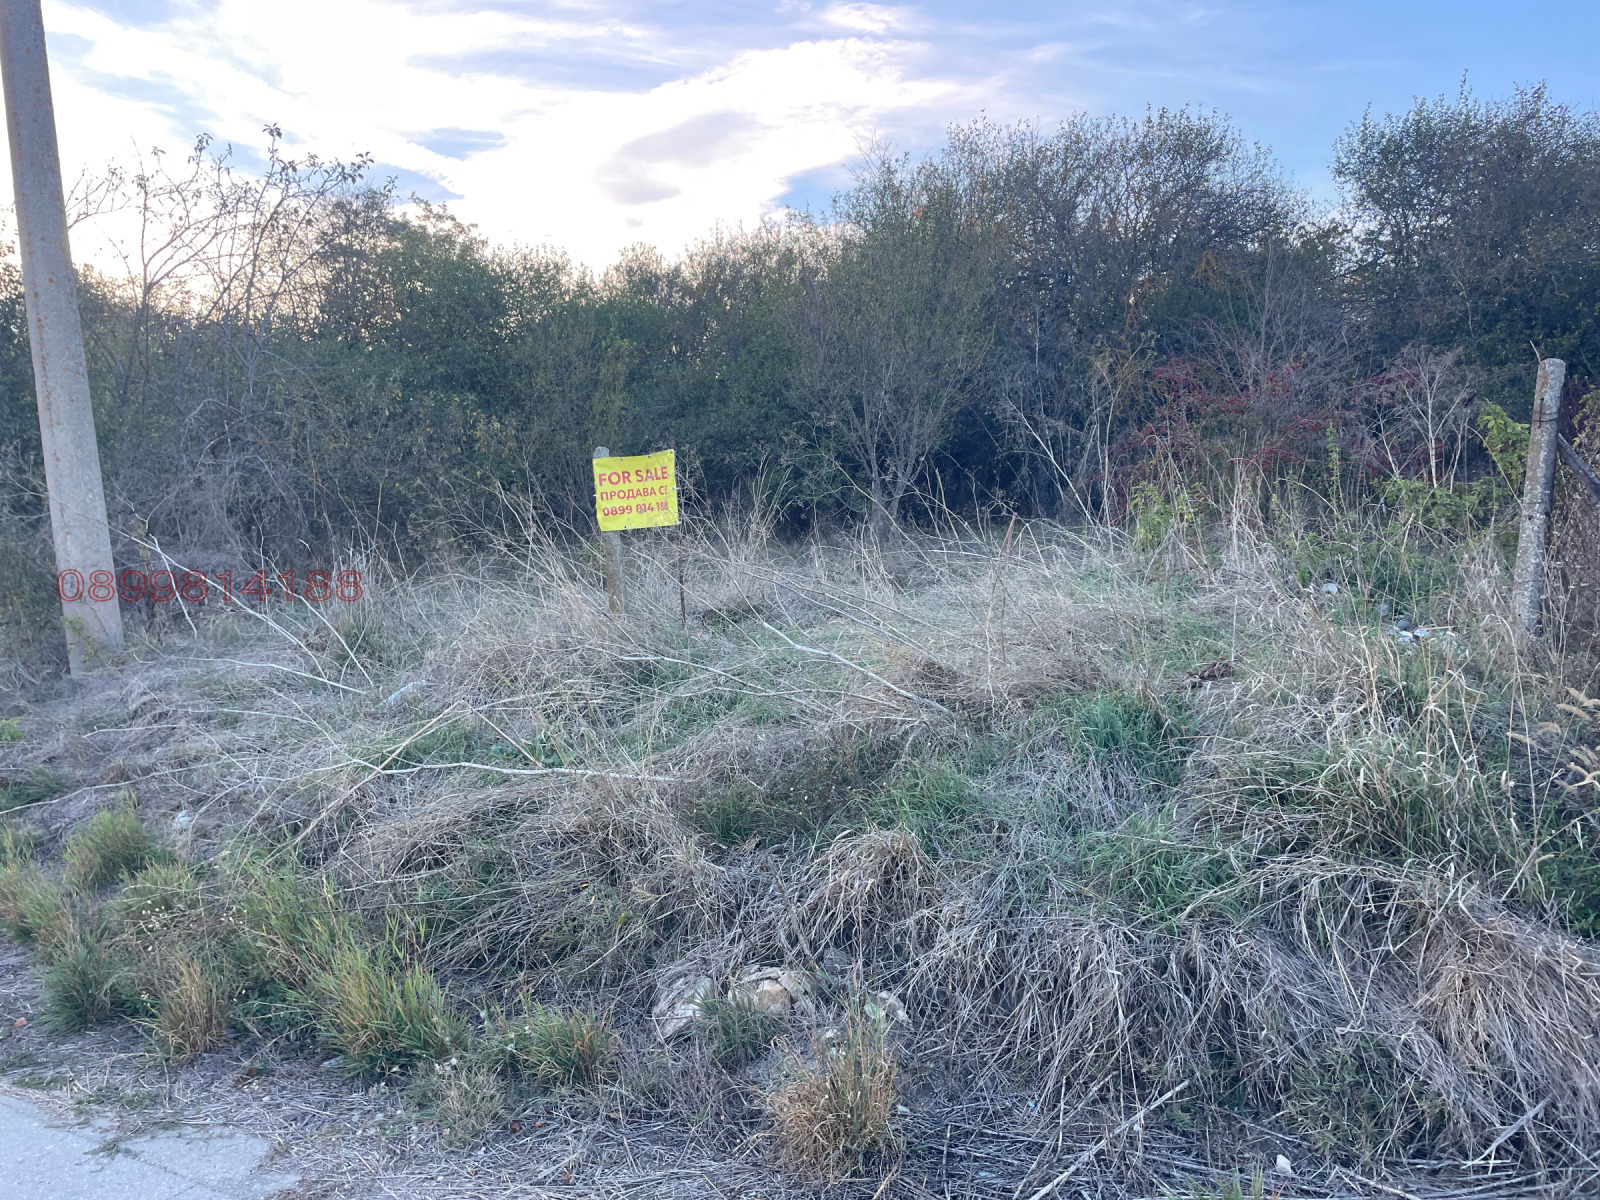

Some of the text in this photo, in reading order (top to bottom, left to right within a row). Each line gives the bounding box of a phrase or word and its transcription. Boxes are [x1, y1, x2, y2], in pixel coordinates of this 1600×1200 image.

[598, 466, 668, 486] FOR SALE
[600, 487, 657, 501] ПРОДАВА
[602, 504, 633, 516] 0899
[635, 502, 654, 514] 814
